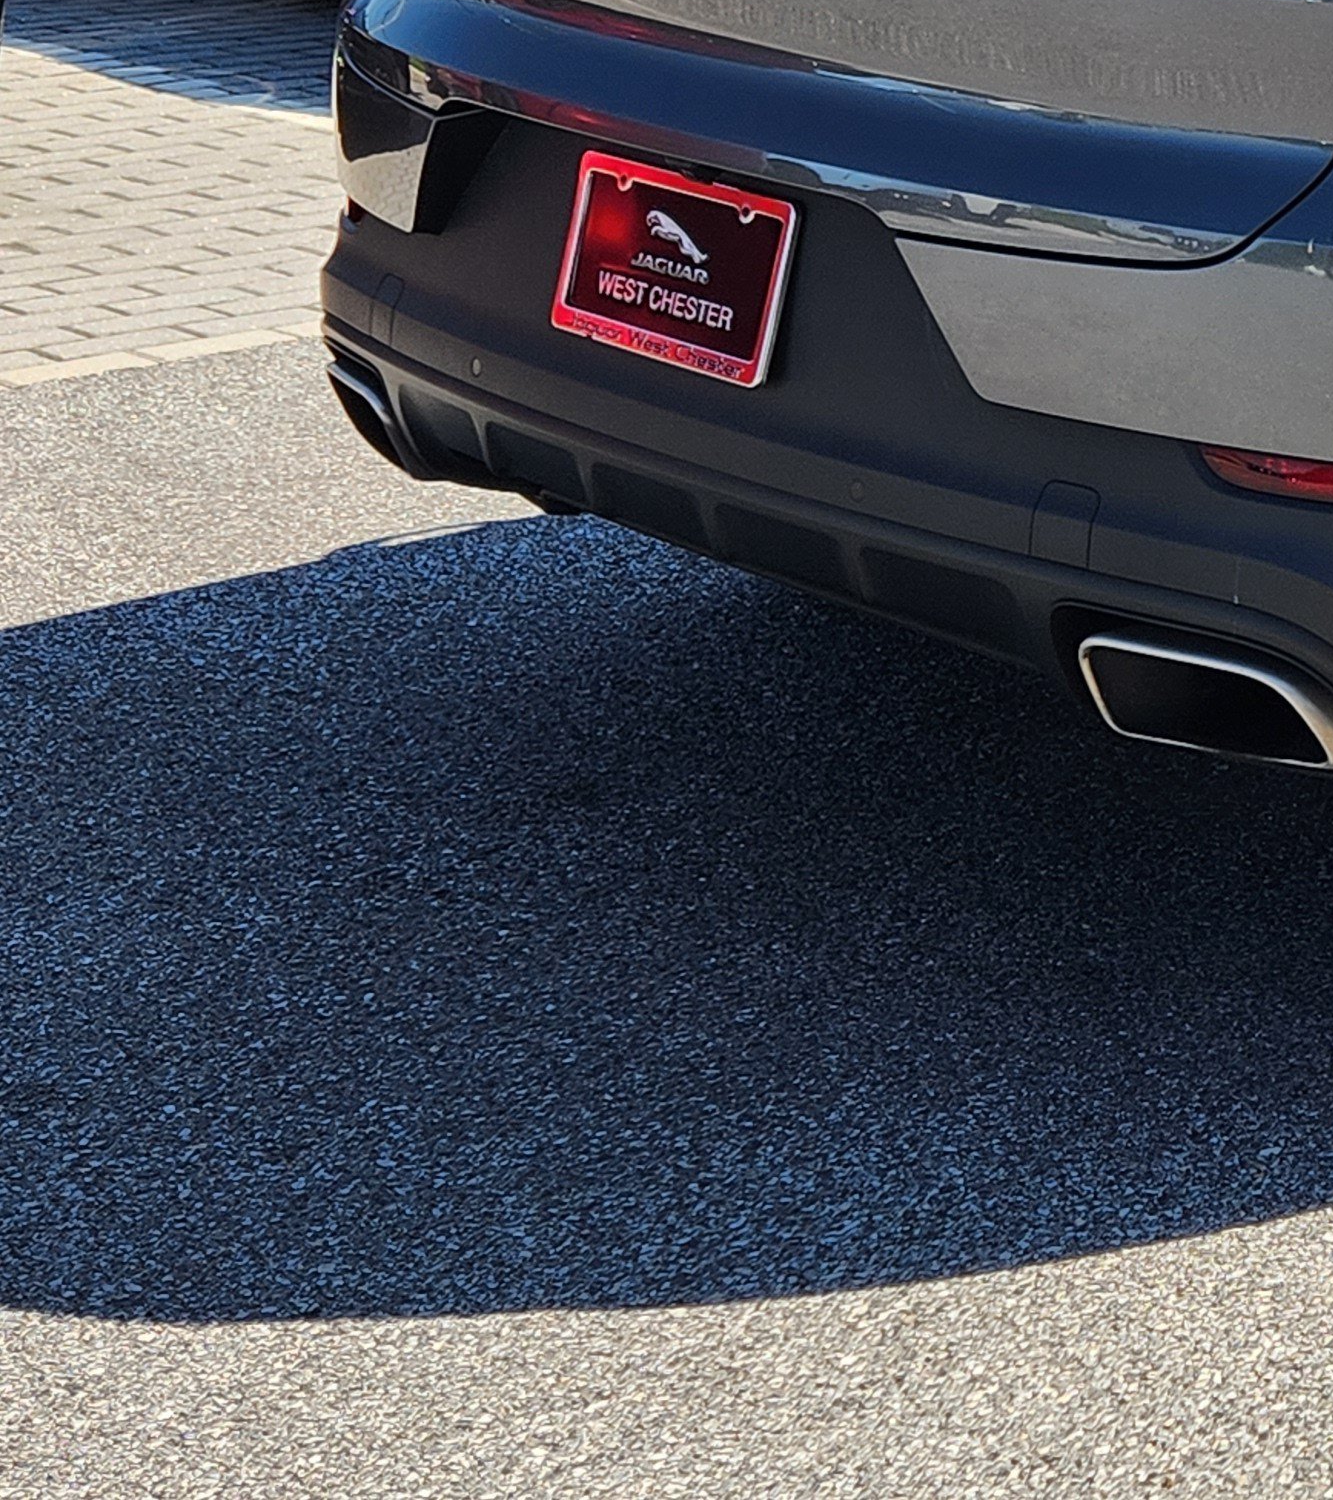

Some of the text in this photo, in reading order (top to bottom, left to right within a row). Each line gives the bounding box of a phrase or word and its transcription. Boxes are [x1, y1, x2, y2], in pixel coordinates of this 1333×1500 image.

[631, 252, 710, 285] JAGUAR
[598, 270, 733, 331] WEST CHESTER
[628, 329, 671, 353] West
[674, 343, 744, 378] Chester
